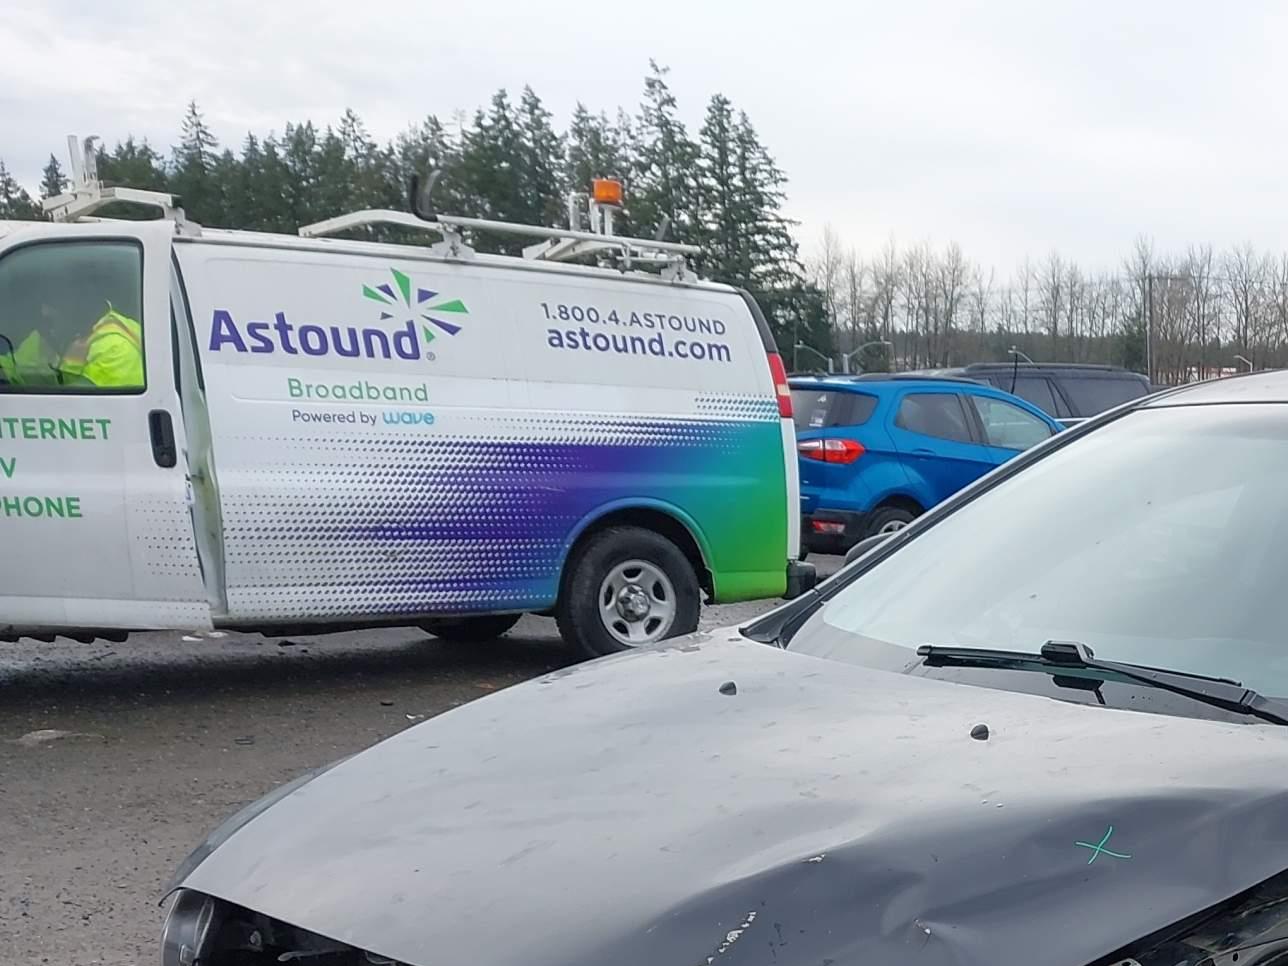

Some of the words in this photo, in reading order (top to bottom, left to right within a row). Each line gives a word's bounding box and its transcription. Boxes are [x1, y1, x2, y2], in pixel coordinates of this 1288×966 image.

[541, 303, 726, 335] 1.800.4.ASTOUND
[208, 309, 422, 360] Astound
[548, 327, 731, 362] astound.com
[287, 377, 429, 401] Broadband
[0, 417, 111, 440] TERNET
[292, 409, 356, 424] Powered
[359, 411, 377, 426] by
[382, 411, 435, 425] wave
[0, 496, 83, 518] HONE
